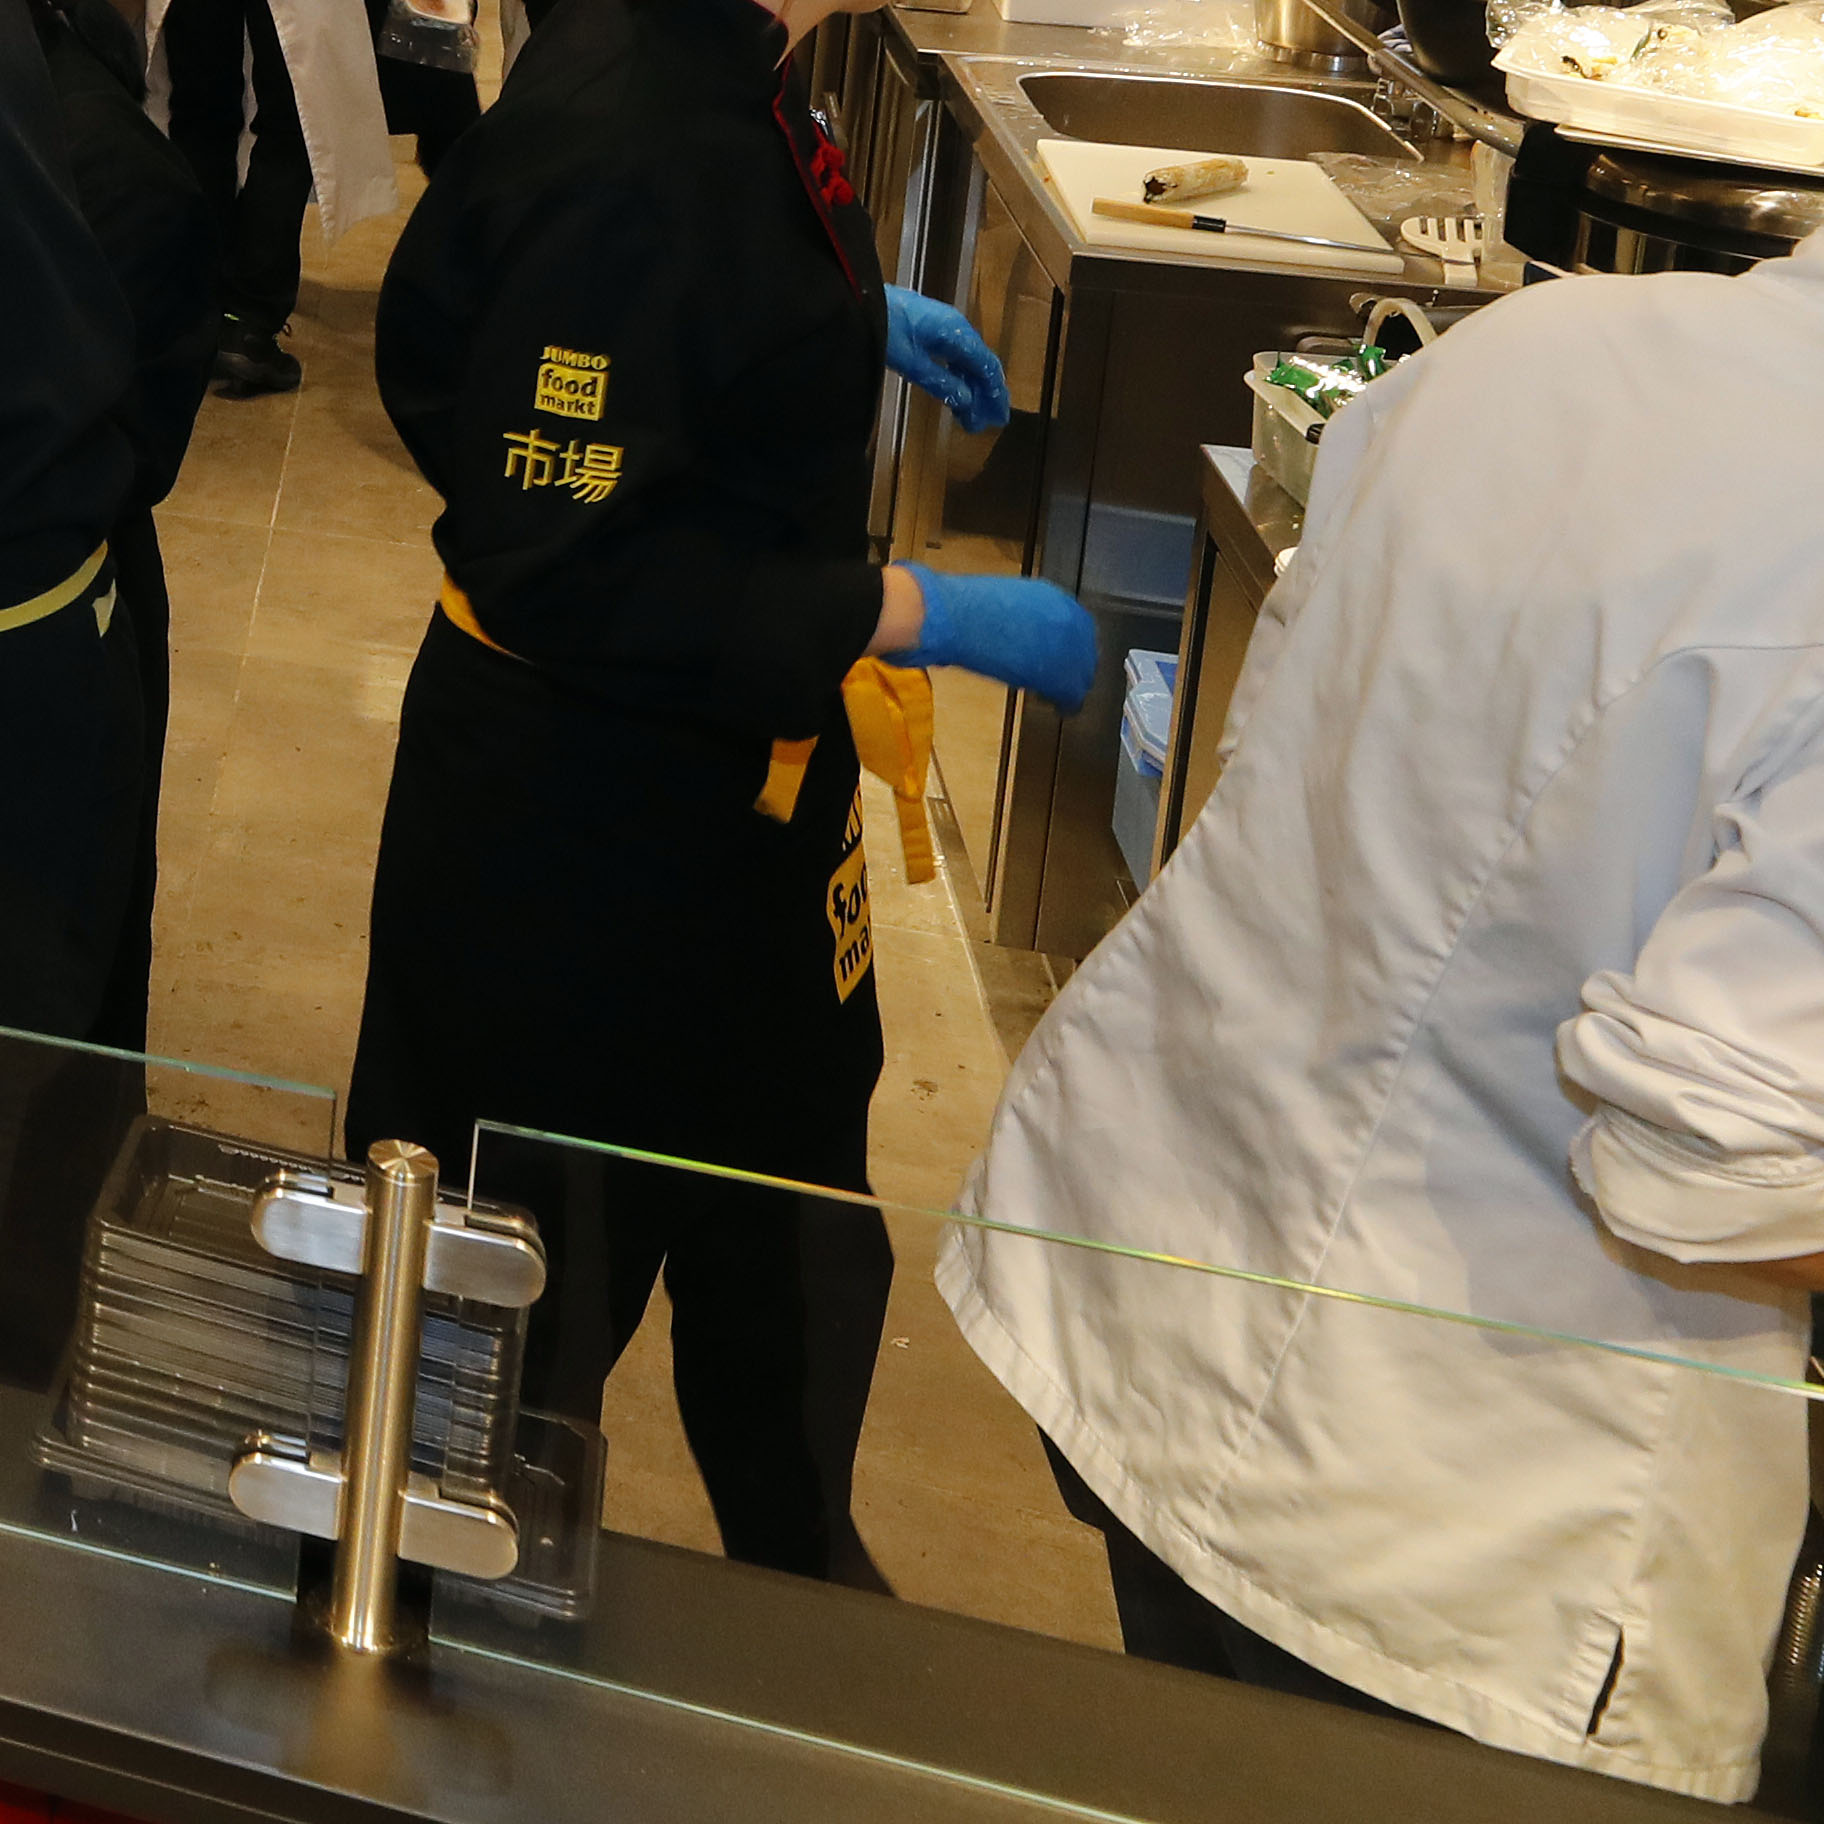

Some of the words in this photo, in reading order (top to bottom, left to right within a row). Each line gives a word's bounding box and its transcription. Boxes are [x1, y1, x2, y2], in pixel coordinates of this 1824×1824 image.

[539, 344, 612, 371] JUMBO
[540, 367, 599, 398] food
[539, 393, 597, 417] markt
[502, 428, 625, 504] 市場
